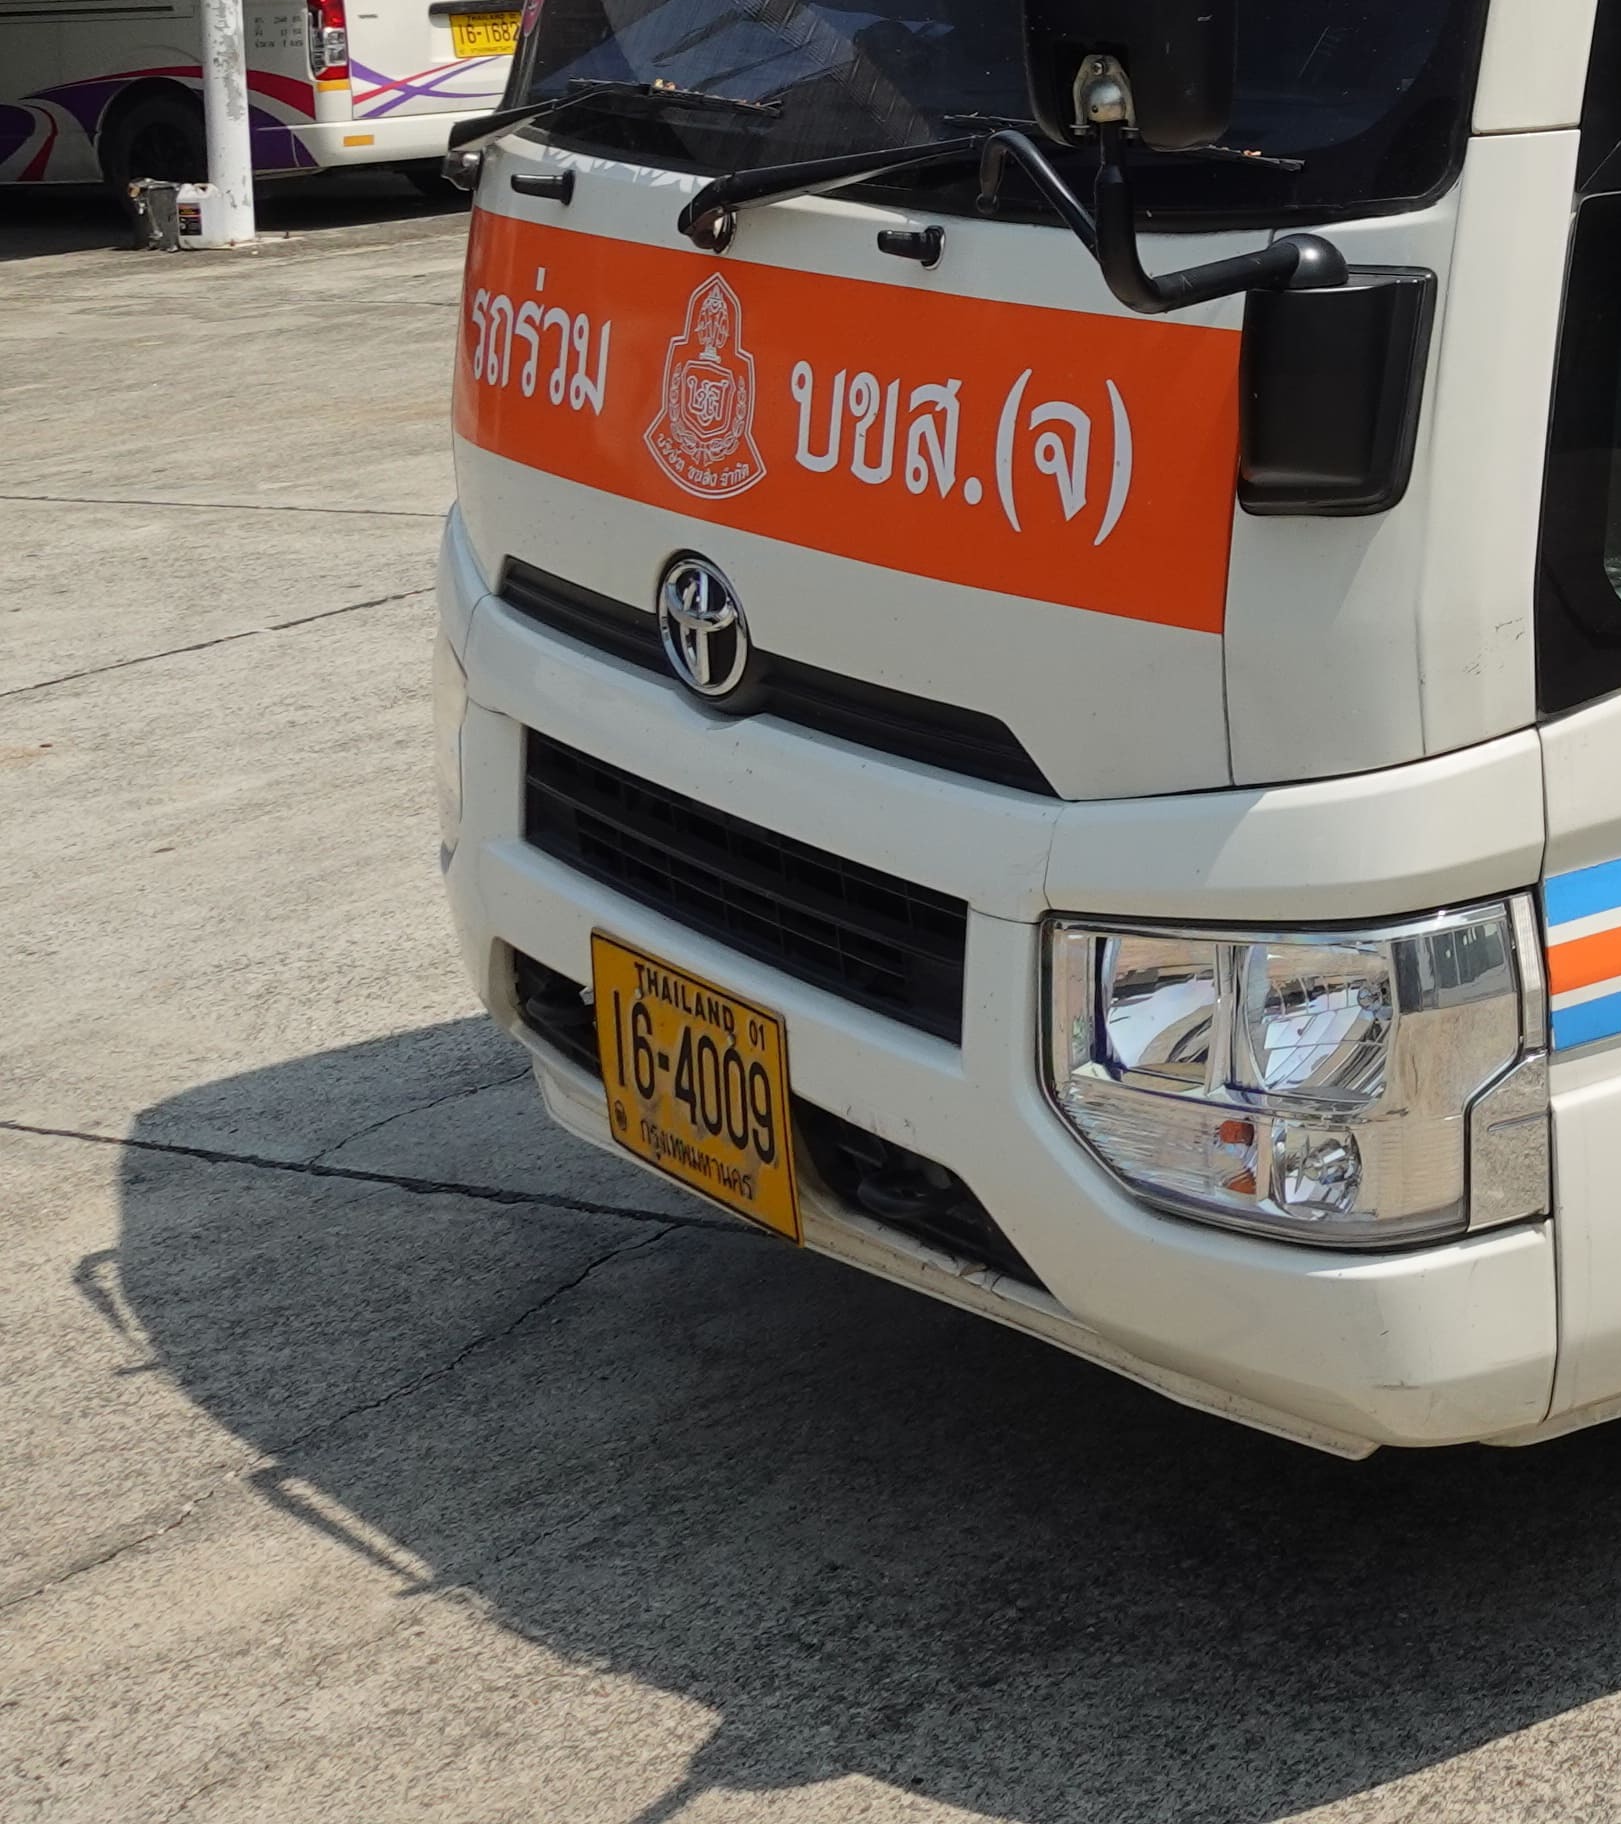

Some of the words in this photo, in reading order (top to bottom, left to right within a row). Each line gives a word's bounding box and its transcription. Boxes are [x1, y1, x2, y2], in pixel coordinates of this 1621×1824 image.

[471, 266, 611, 416] รถร่วม
[790, 361, 1134, 547] บขส.(จ)
[633, 961, 735, 1035] THAILAND
[748, 1018, 766, 1051] 01
[612, 989, 778, 1165] 16-4009
[639, 1118, 754, 1201] กรุงเทพมหานคร
